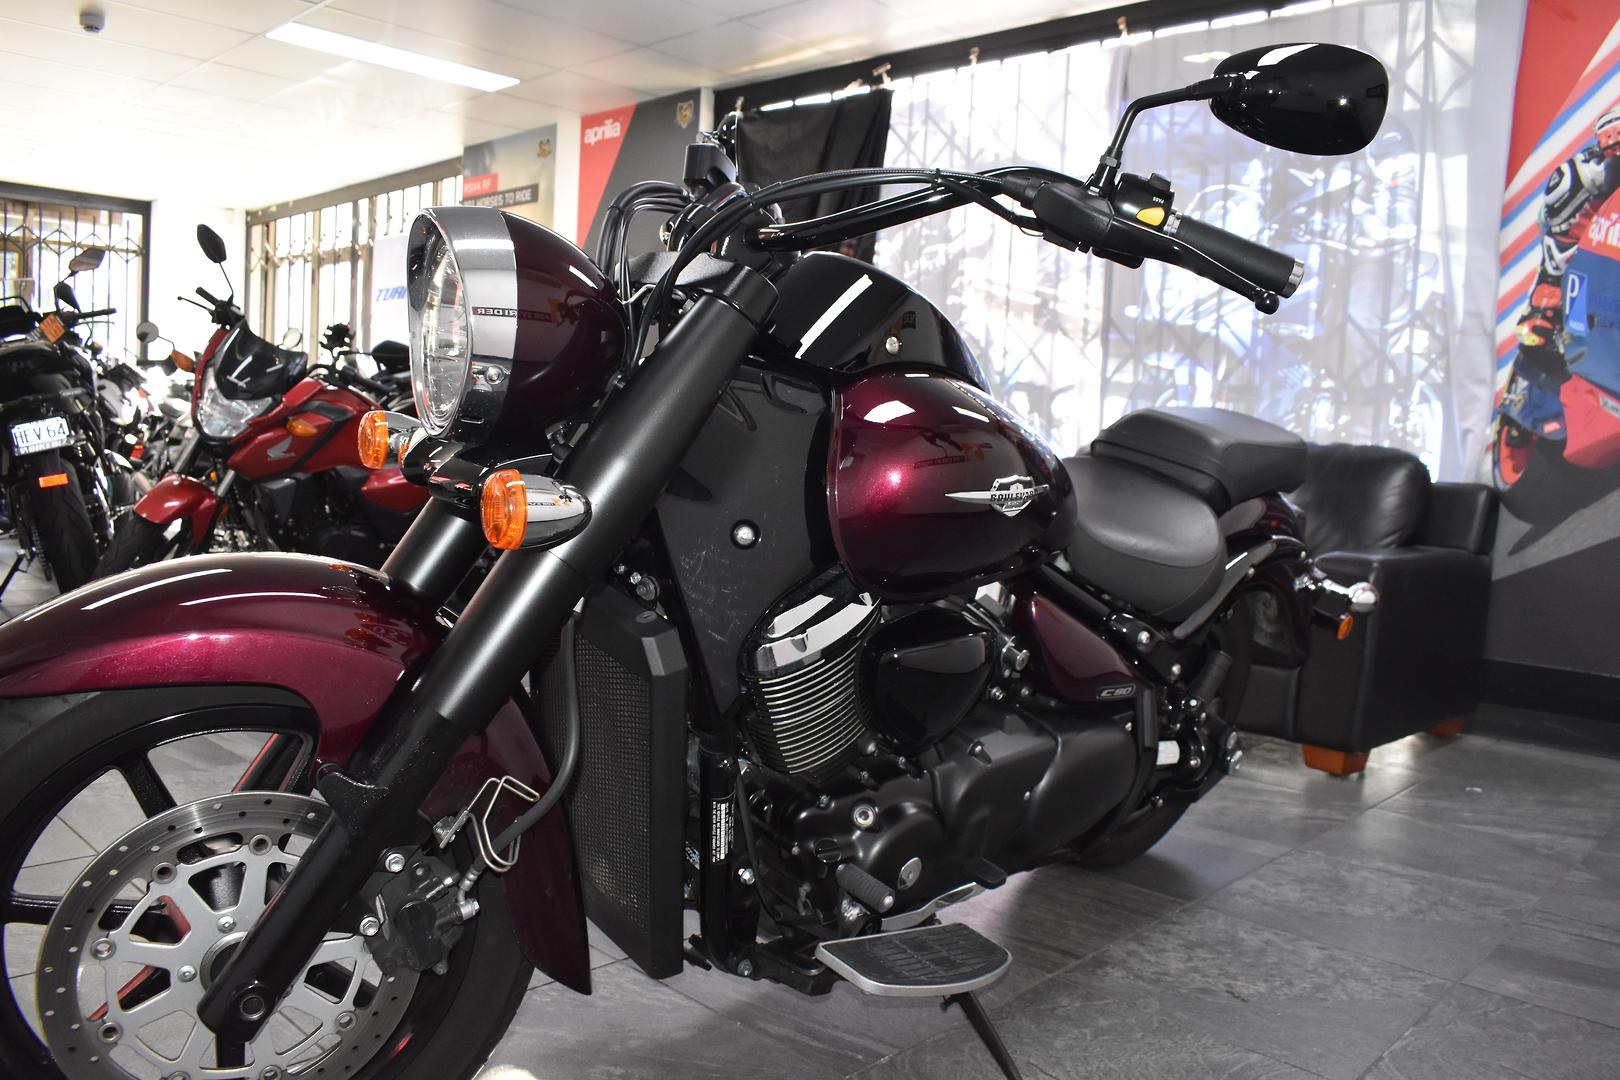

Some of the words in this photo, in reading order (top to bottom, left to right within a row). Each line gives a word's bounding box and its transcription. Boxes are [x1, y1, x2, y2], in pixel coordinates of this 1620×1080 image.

[584, 118, 621, 146] aprilia
[504, 191, 515, 205] TO
[515, 188, 532, 203] RIDE
[1152, 196, 1165, 204] PASS
